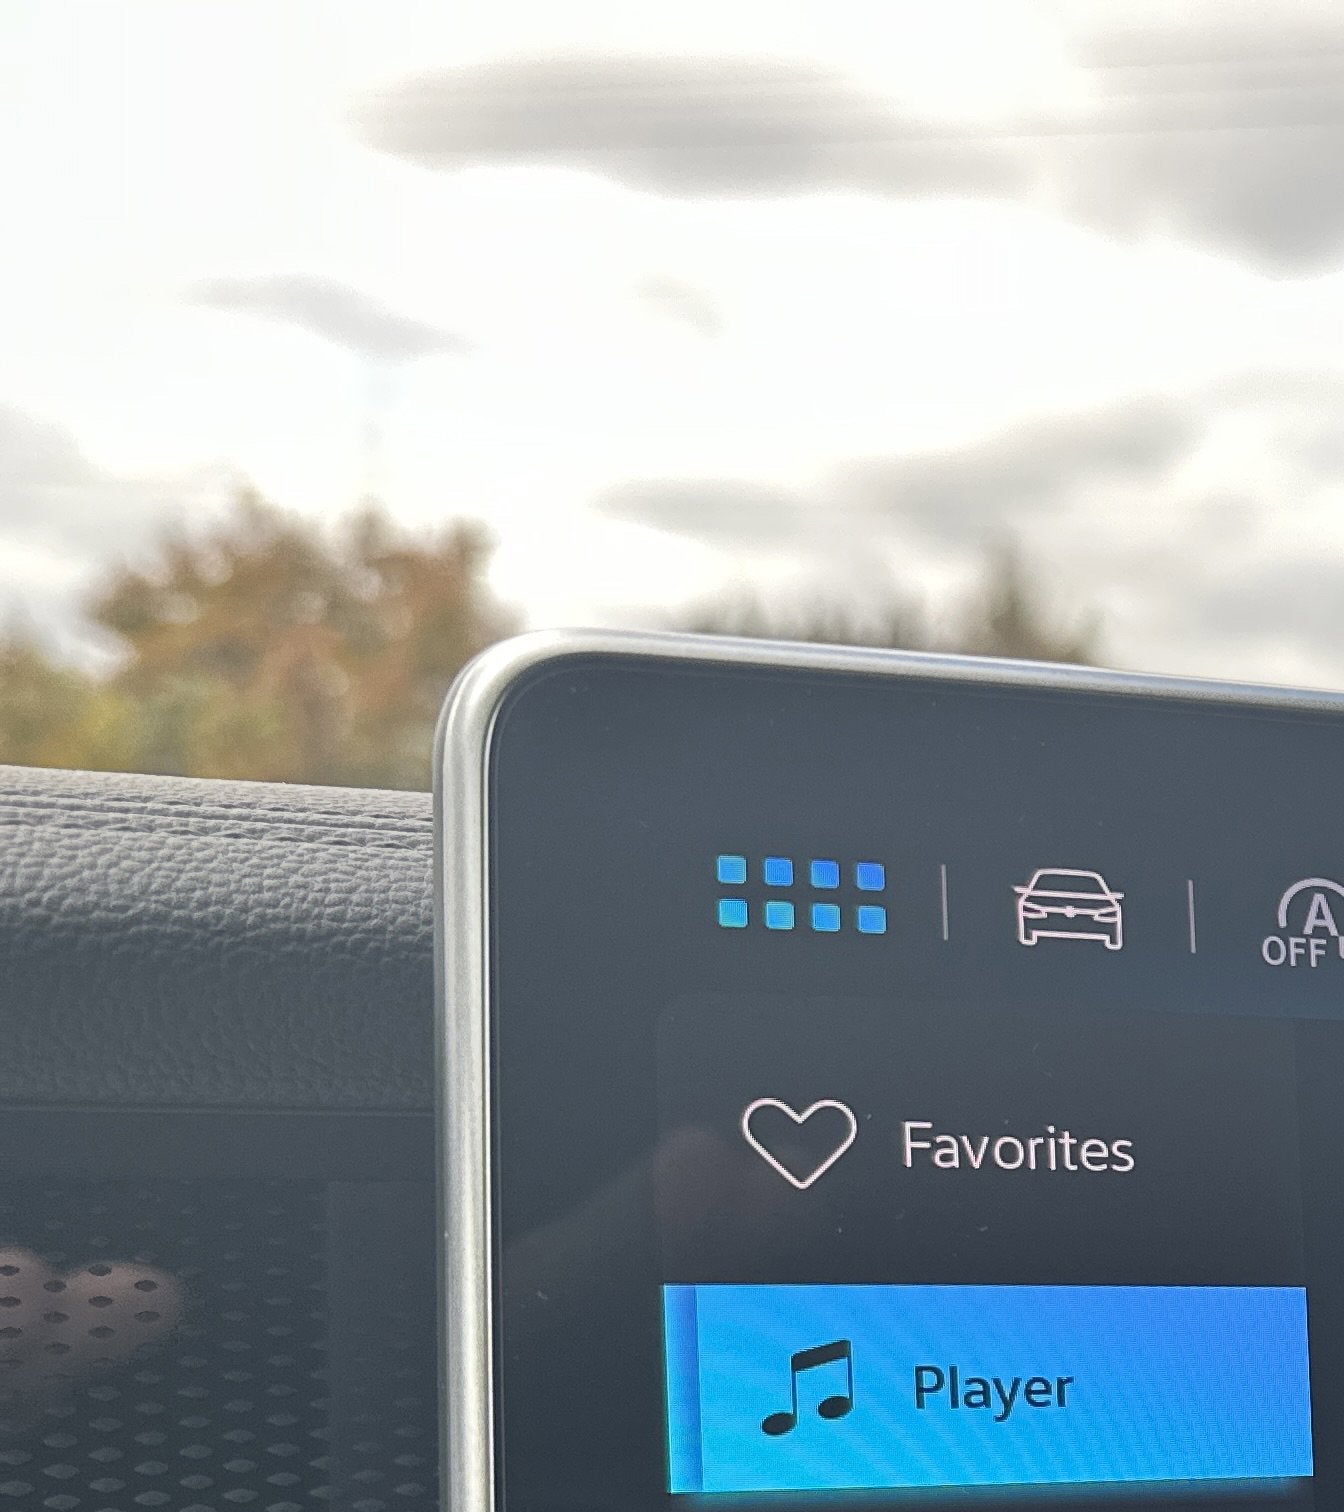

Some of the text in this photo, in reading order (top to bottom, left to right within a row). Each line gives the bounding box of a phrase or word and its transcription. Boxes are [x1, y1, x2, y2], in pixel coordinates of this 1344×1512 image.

[1261, 935, 1327, 968] OFF
[903, 1121, 1135, 1172] Favorites
[914, 1365, 1075, 1422] Player
